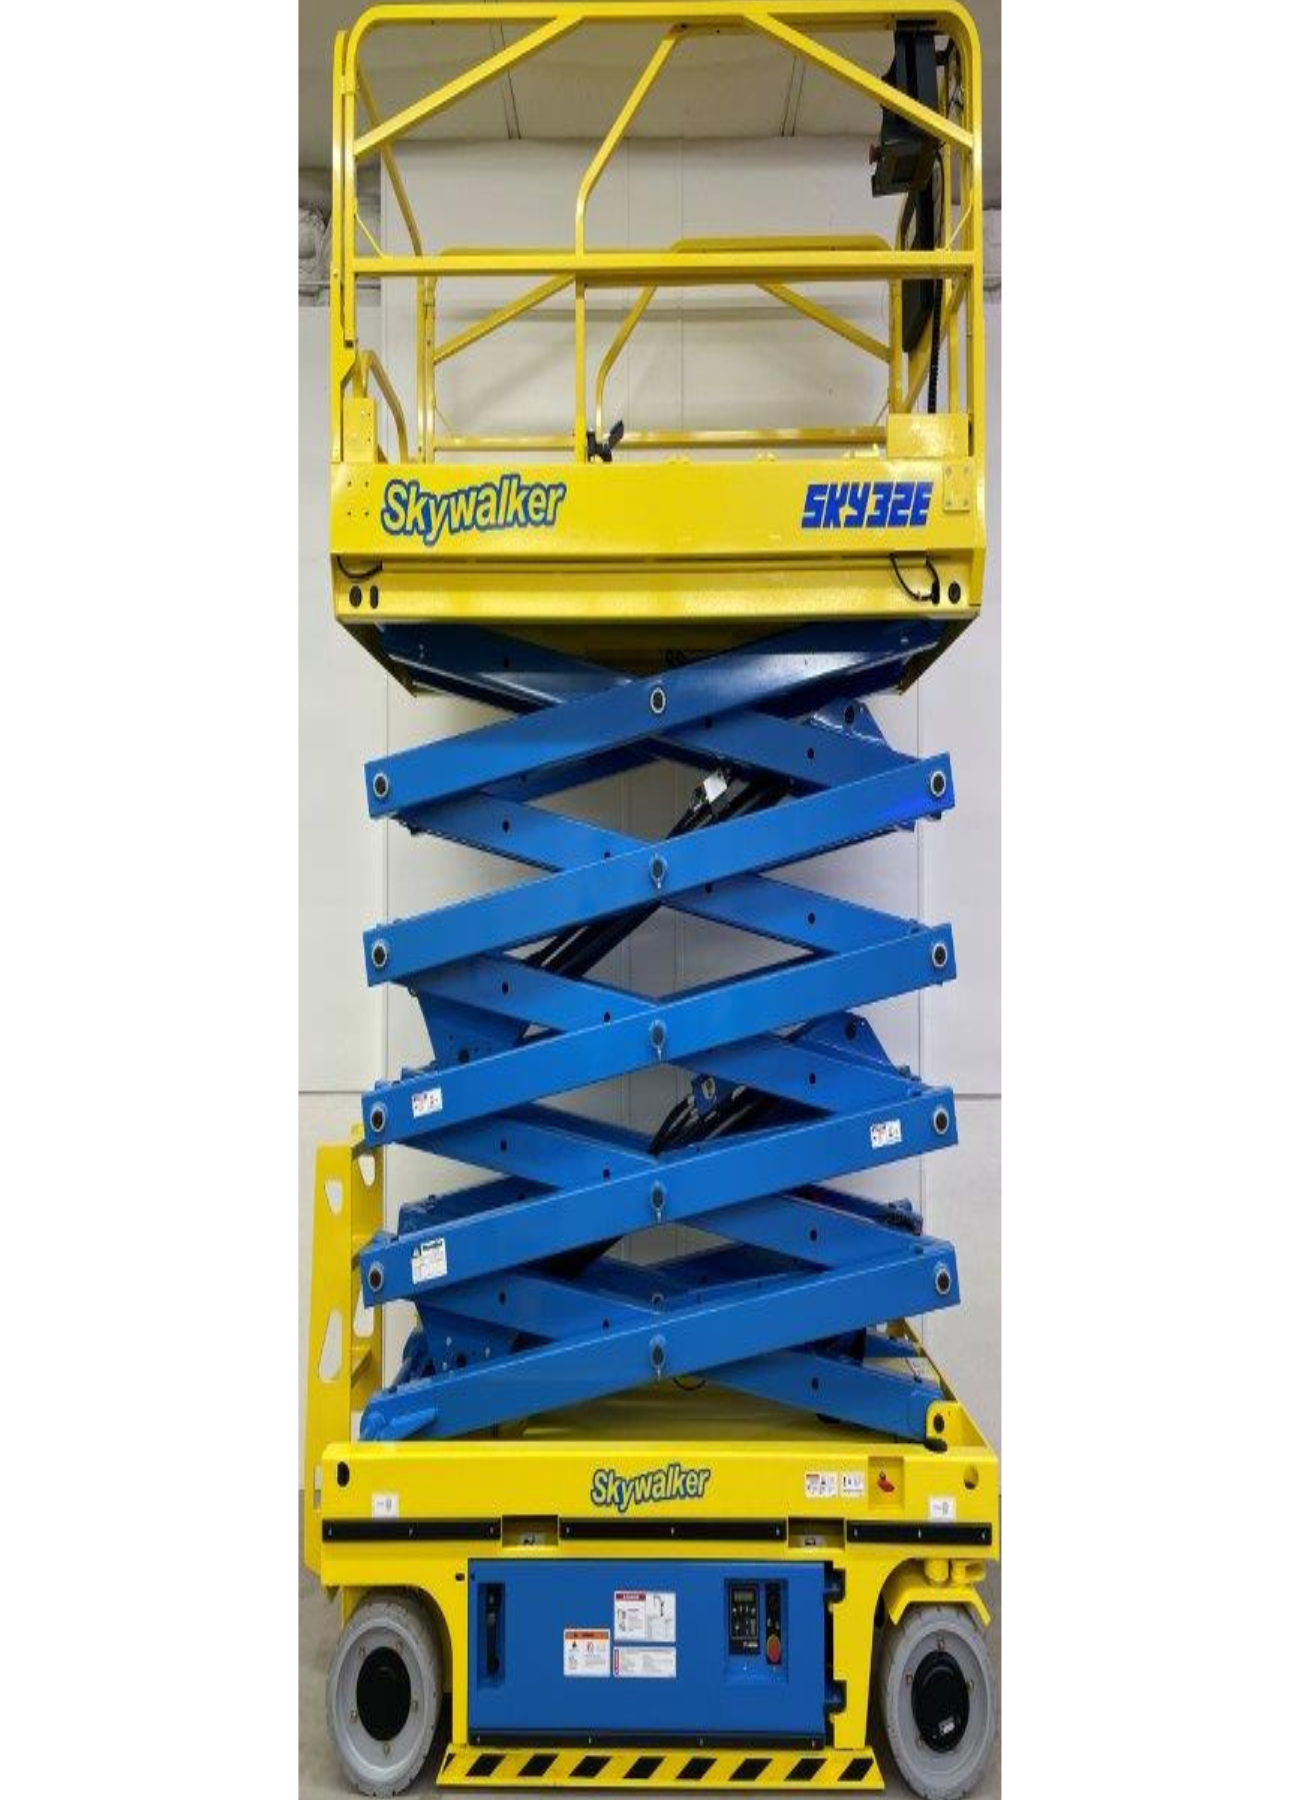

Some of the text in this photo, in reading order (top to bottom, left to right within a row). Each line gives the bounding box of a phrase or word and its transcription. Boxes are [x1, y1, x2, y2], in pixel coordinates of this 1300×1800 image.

[381, 474, 567, 546] Skywalker
[801, 481, 934, 528] SKY32E
[591, 1463, 711, 1513] Skywalker
